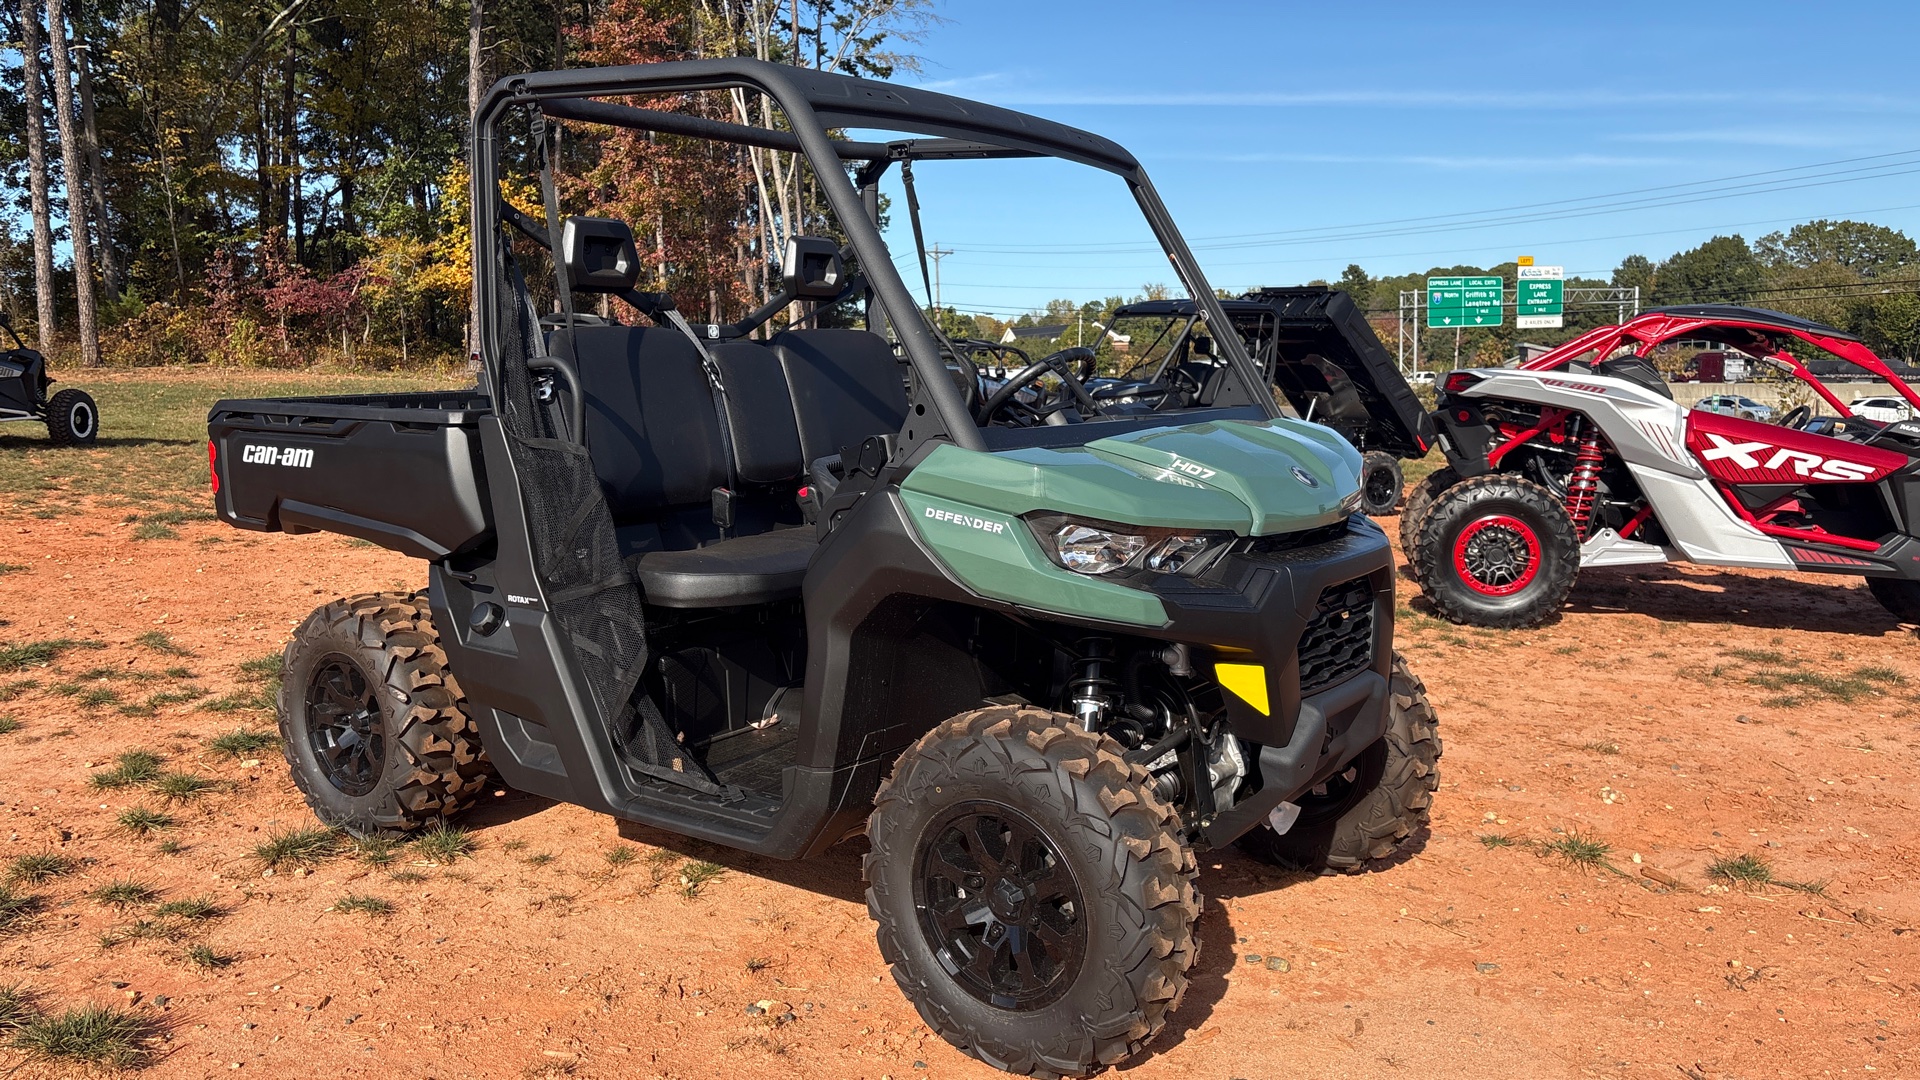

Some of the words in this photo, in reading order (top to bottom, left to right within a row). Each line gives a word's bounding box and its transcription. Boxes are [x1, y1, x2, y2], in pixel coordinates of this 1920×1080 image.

[1489, 290, 1495, 298] St
[242, 444, 314, 468] can-am
[1700, 433, 1876, 481] XRS
[1171, 459, 1216, 479] HD7
[925, 507, 1004, 534] DEFENDER
[507, 594, 529, 604] ROTAX
